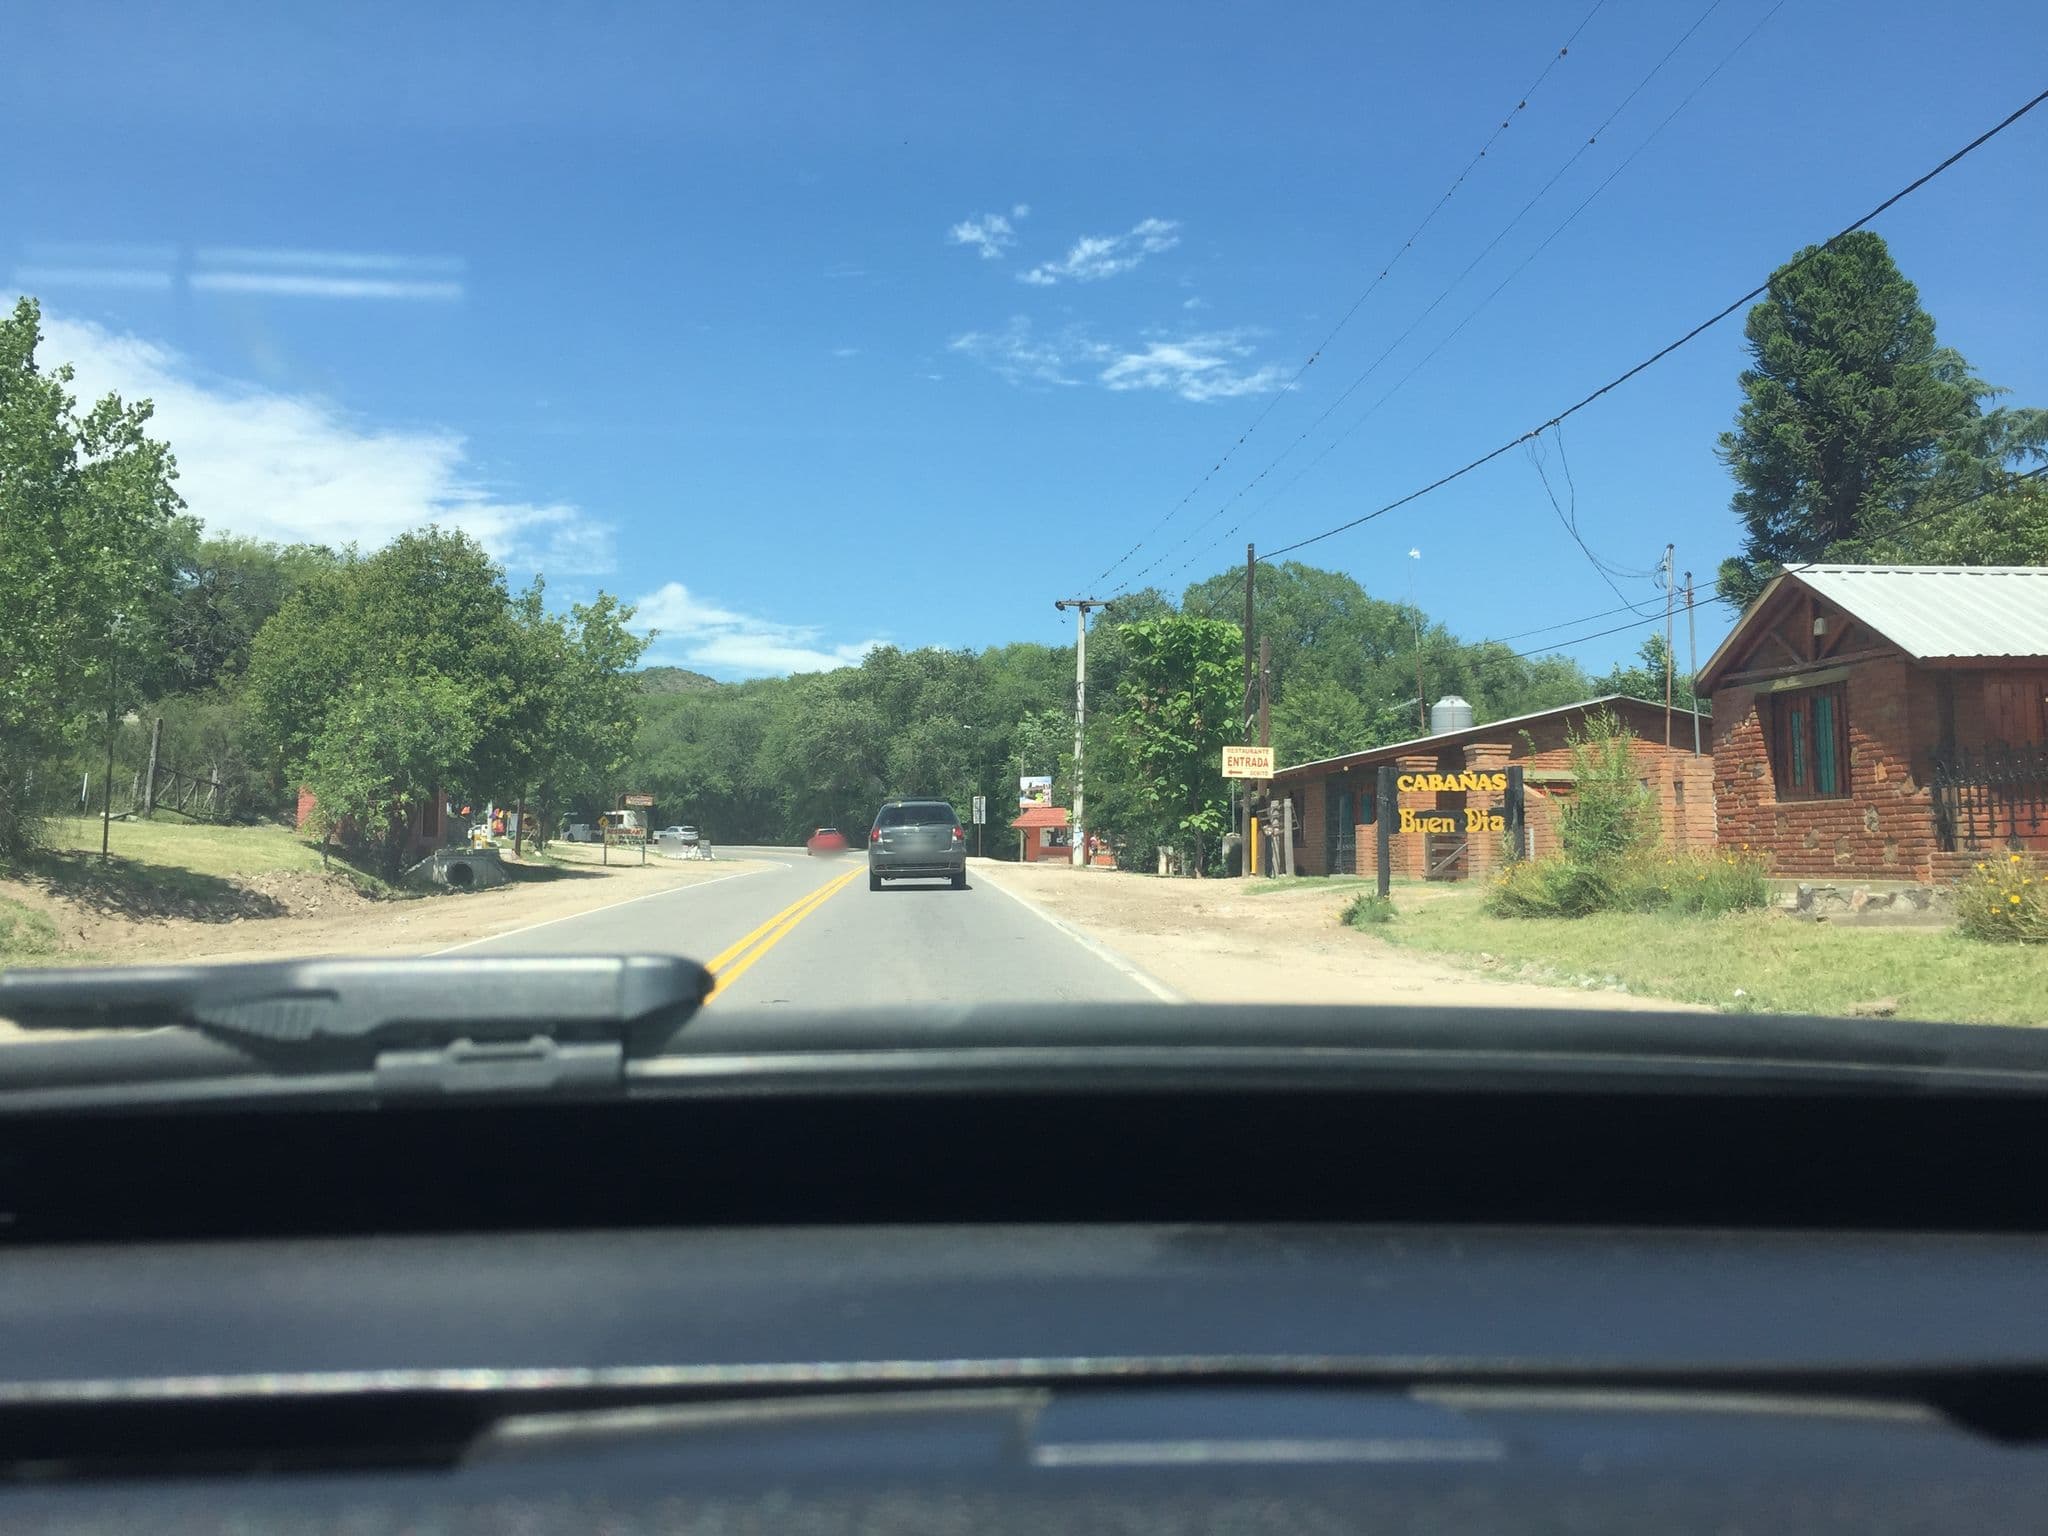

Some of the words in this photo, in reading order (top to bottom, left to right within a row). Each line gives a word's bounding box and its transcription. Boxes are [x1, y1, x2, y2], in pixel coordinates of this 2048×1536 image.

[1227, 756, 1269, 767] ENTRADA
[1397, 770, 1507, 792] CABAÑAS
[1398, 808, 1455, 833] Buen
